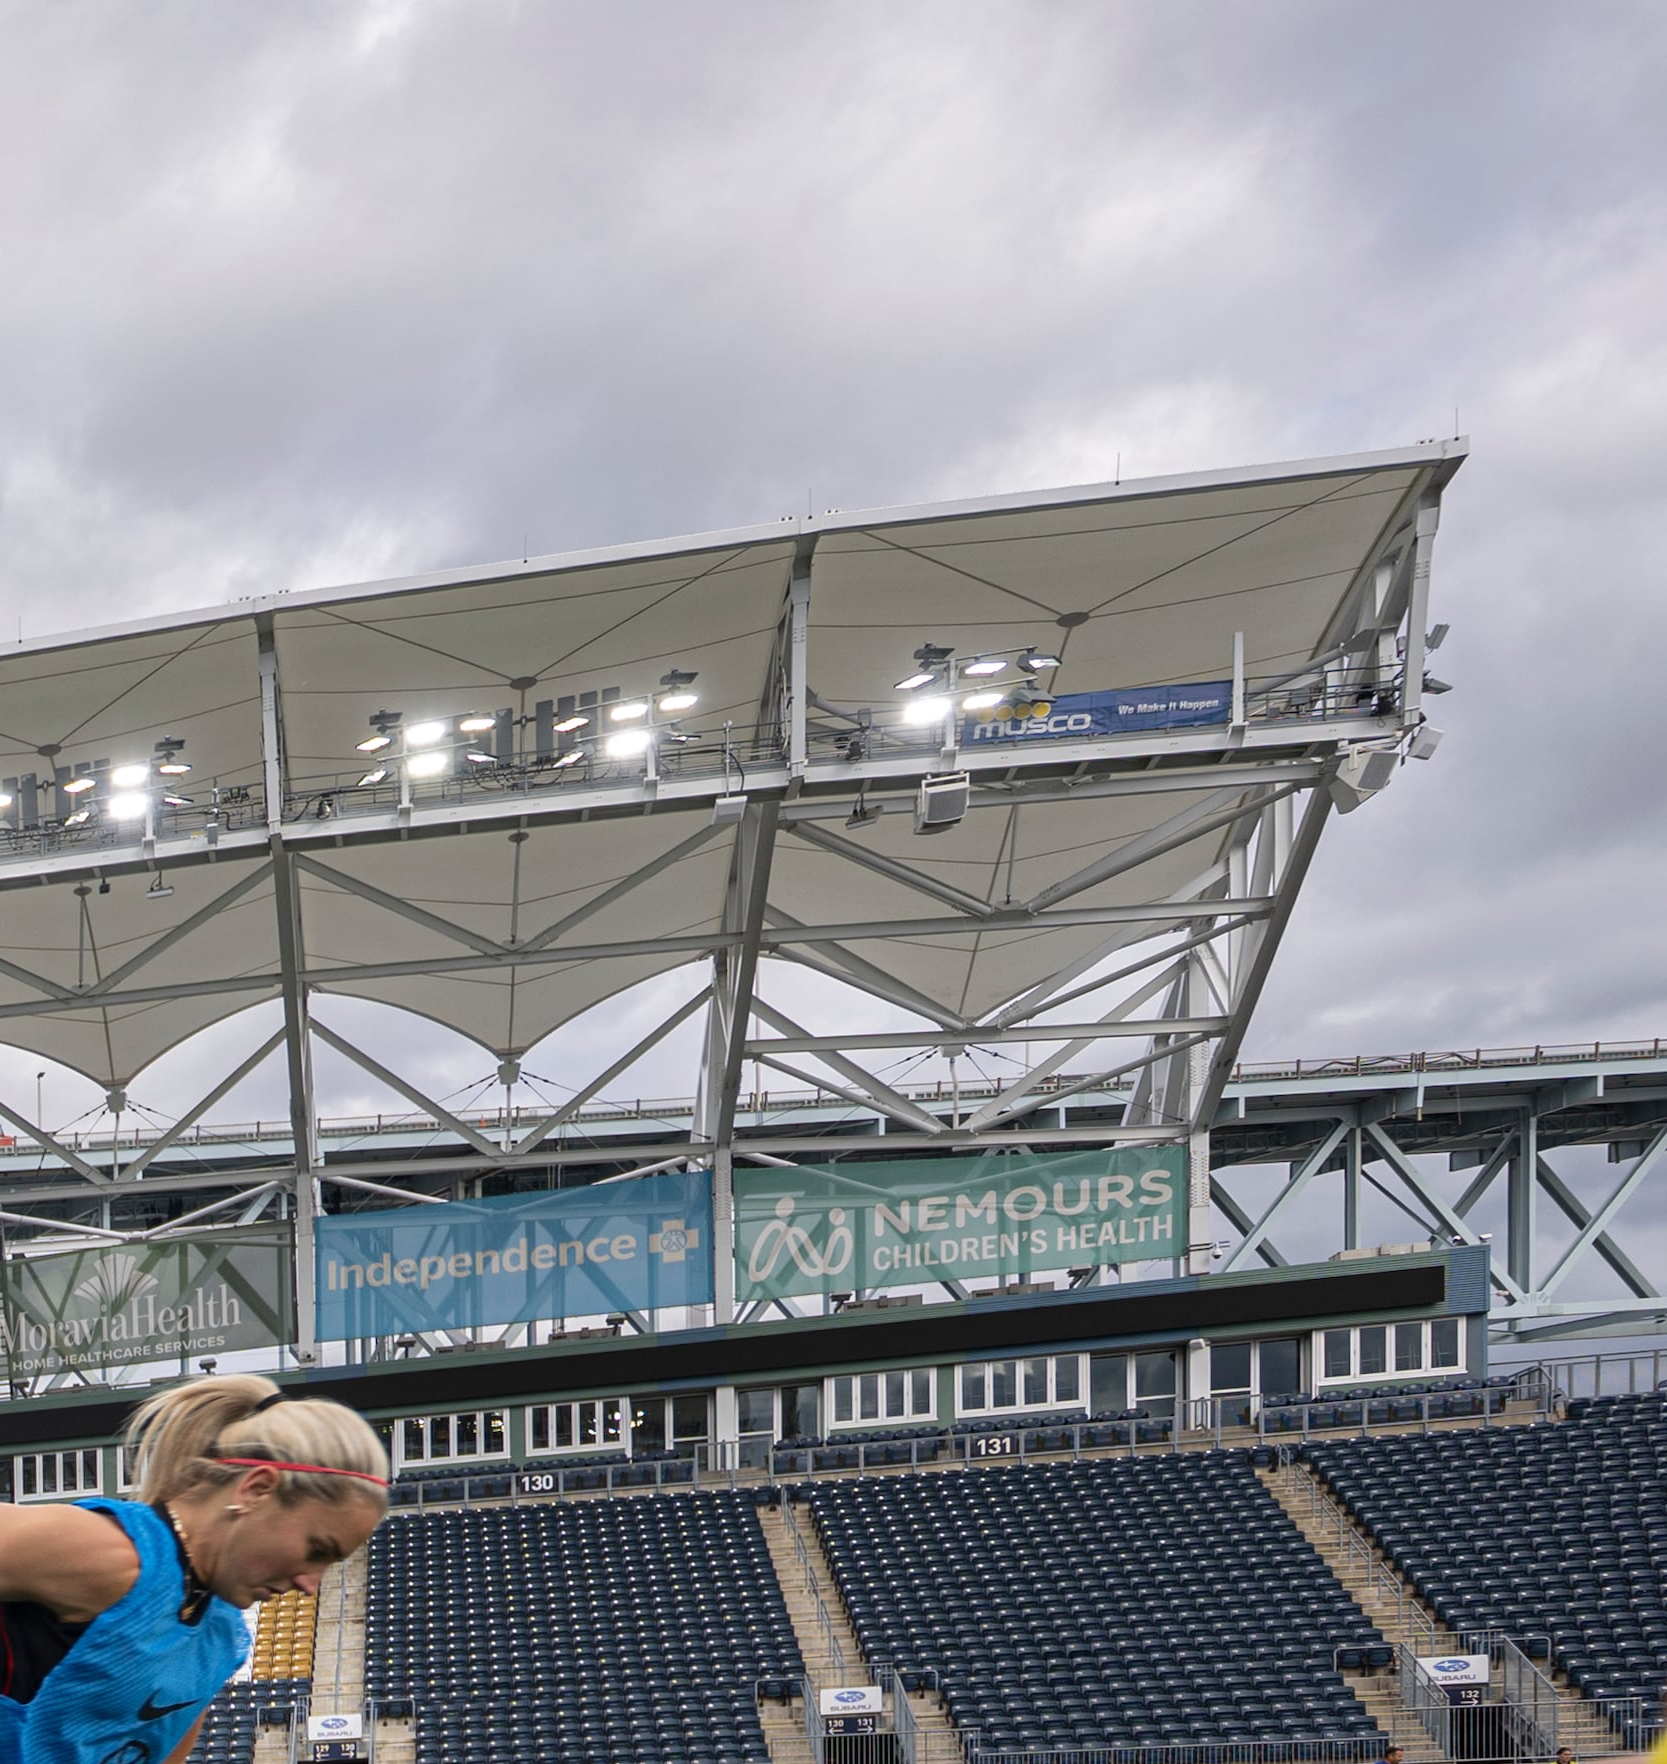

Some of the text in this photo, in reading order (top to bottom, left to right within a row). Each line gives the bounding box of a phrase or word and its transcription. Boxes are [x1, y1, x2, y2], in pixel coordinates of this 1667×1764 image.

[1118, 704, 1135, 715] We
[1137, 702, 1166, 713] Make
[1168, 701, 1177, 711] It
[873, 1169, 1173, 1237] NEMOURS
[873, 1213, 1173, 1271] CHILDREN'S HEALTH
[327, 1233, 637, 1290] Independence
[12, 1335, 225, 1372] HOME HEALTHCARE SERVICES
[976, 1437, 1012, 1455] 131
[520, 1474, 554, 1491] 130
[1460, 1690, 1480, 1699] 132
[830, 1704, 872, 1712] SUBARU
[828, 1718, 873, 1728] 130 131
